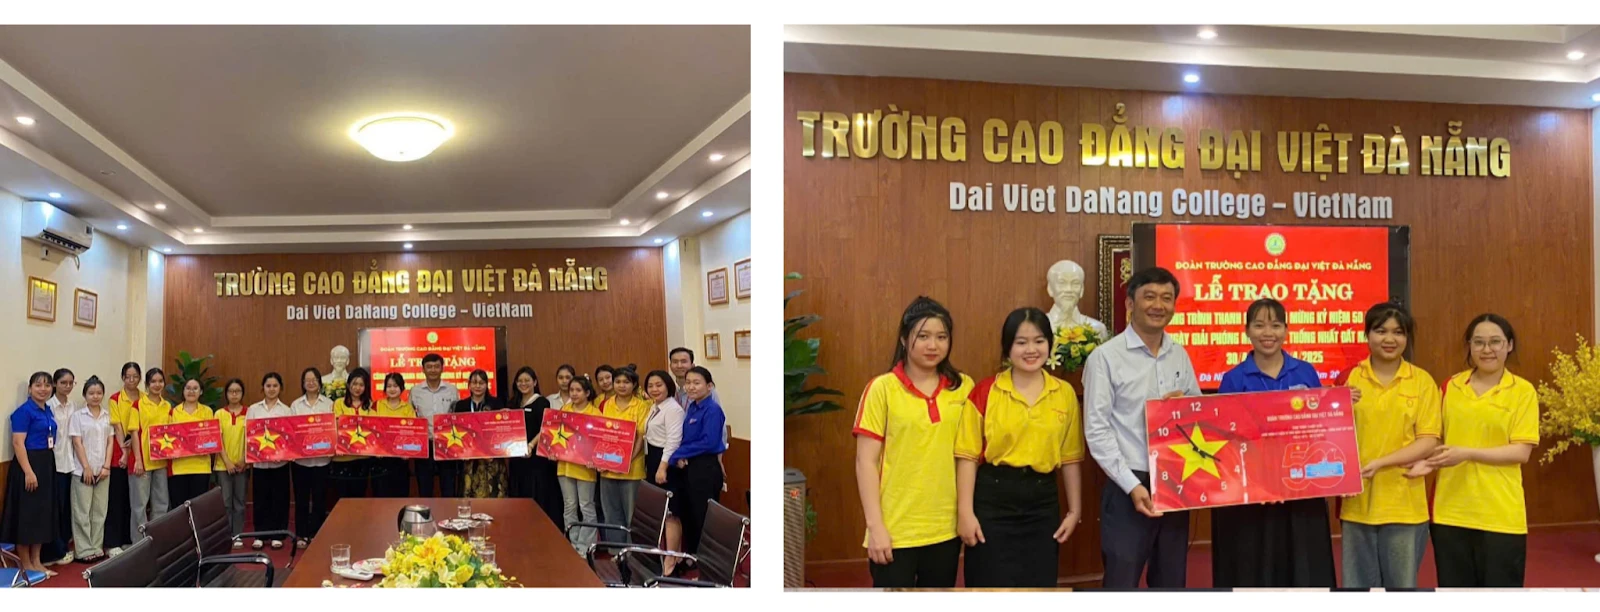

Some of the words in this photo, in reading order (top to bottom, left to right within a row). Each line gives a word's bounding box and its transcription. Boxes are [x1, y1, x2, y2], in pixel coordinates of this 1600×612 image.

[797, 104, 966, 162] TRƯỜNG
[983, 117, 1065, 165] CAO
[1079, 102, 1186, 169] ĐẲNG
[1198, 127, 1262, 179] ĐẠI
[1277, 123, 1353, 181] VIỆT
[1360, 125, 1410, 176] ĐÀ
[1421, 120, 1511, 178] NẴNG
[949, 182, 993, 211] Dai
[1003, 184, 1056, 214] Viet
[1065, 186, 1163, 218] DaNang
[1171, 188, 1266, 219] College
[1293, 191, 1393, 219] VietNam
[1245, 261, 1265, 270] CAO
[214, 266, 296, 297] TRƯỜNG
[303, 271, 345, 295] CAO
[352, 258, 411, 294] ĐẲNG
[416, 269, 454, 297] ĐẠI
[461, 264, 508, 297] VIỆT
[512, 262, 543, 292] ĐÀ
[549, 257, 608, 291] NẴNG
[1194, 274, 1223, 301] LỄ
[1228, 283, 1289, 301] TRAO
[1293, 278, 1354, 305] TẶNG
[287, 305, 309, 320] Dai
[313, 305, 341, 320] Viet
[345, 304, 398, 320] DaNang
[402, 303, 456, 320] College
[472, 302, 533, 318] VietNam
[1190, 402, 1202, 412] 12
[1171, 411, 1181, 419] 11
[1214, 408, 1219, 416] 1
[1230, 422, 1236, 431] 2
[1158, 427, 1169, 436] 10
[1241, 443, 1248, 452] 3
[1162, 471, 1169, 480] 8
[1176, 485, 1184, 494] 7
[1200, 492, 1207, 502] 6
